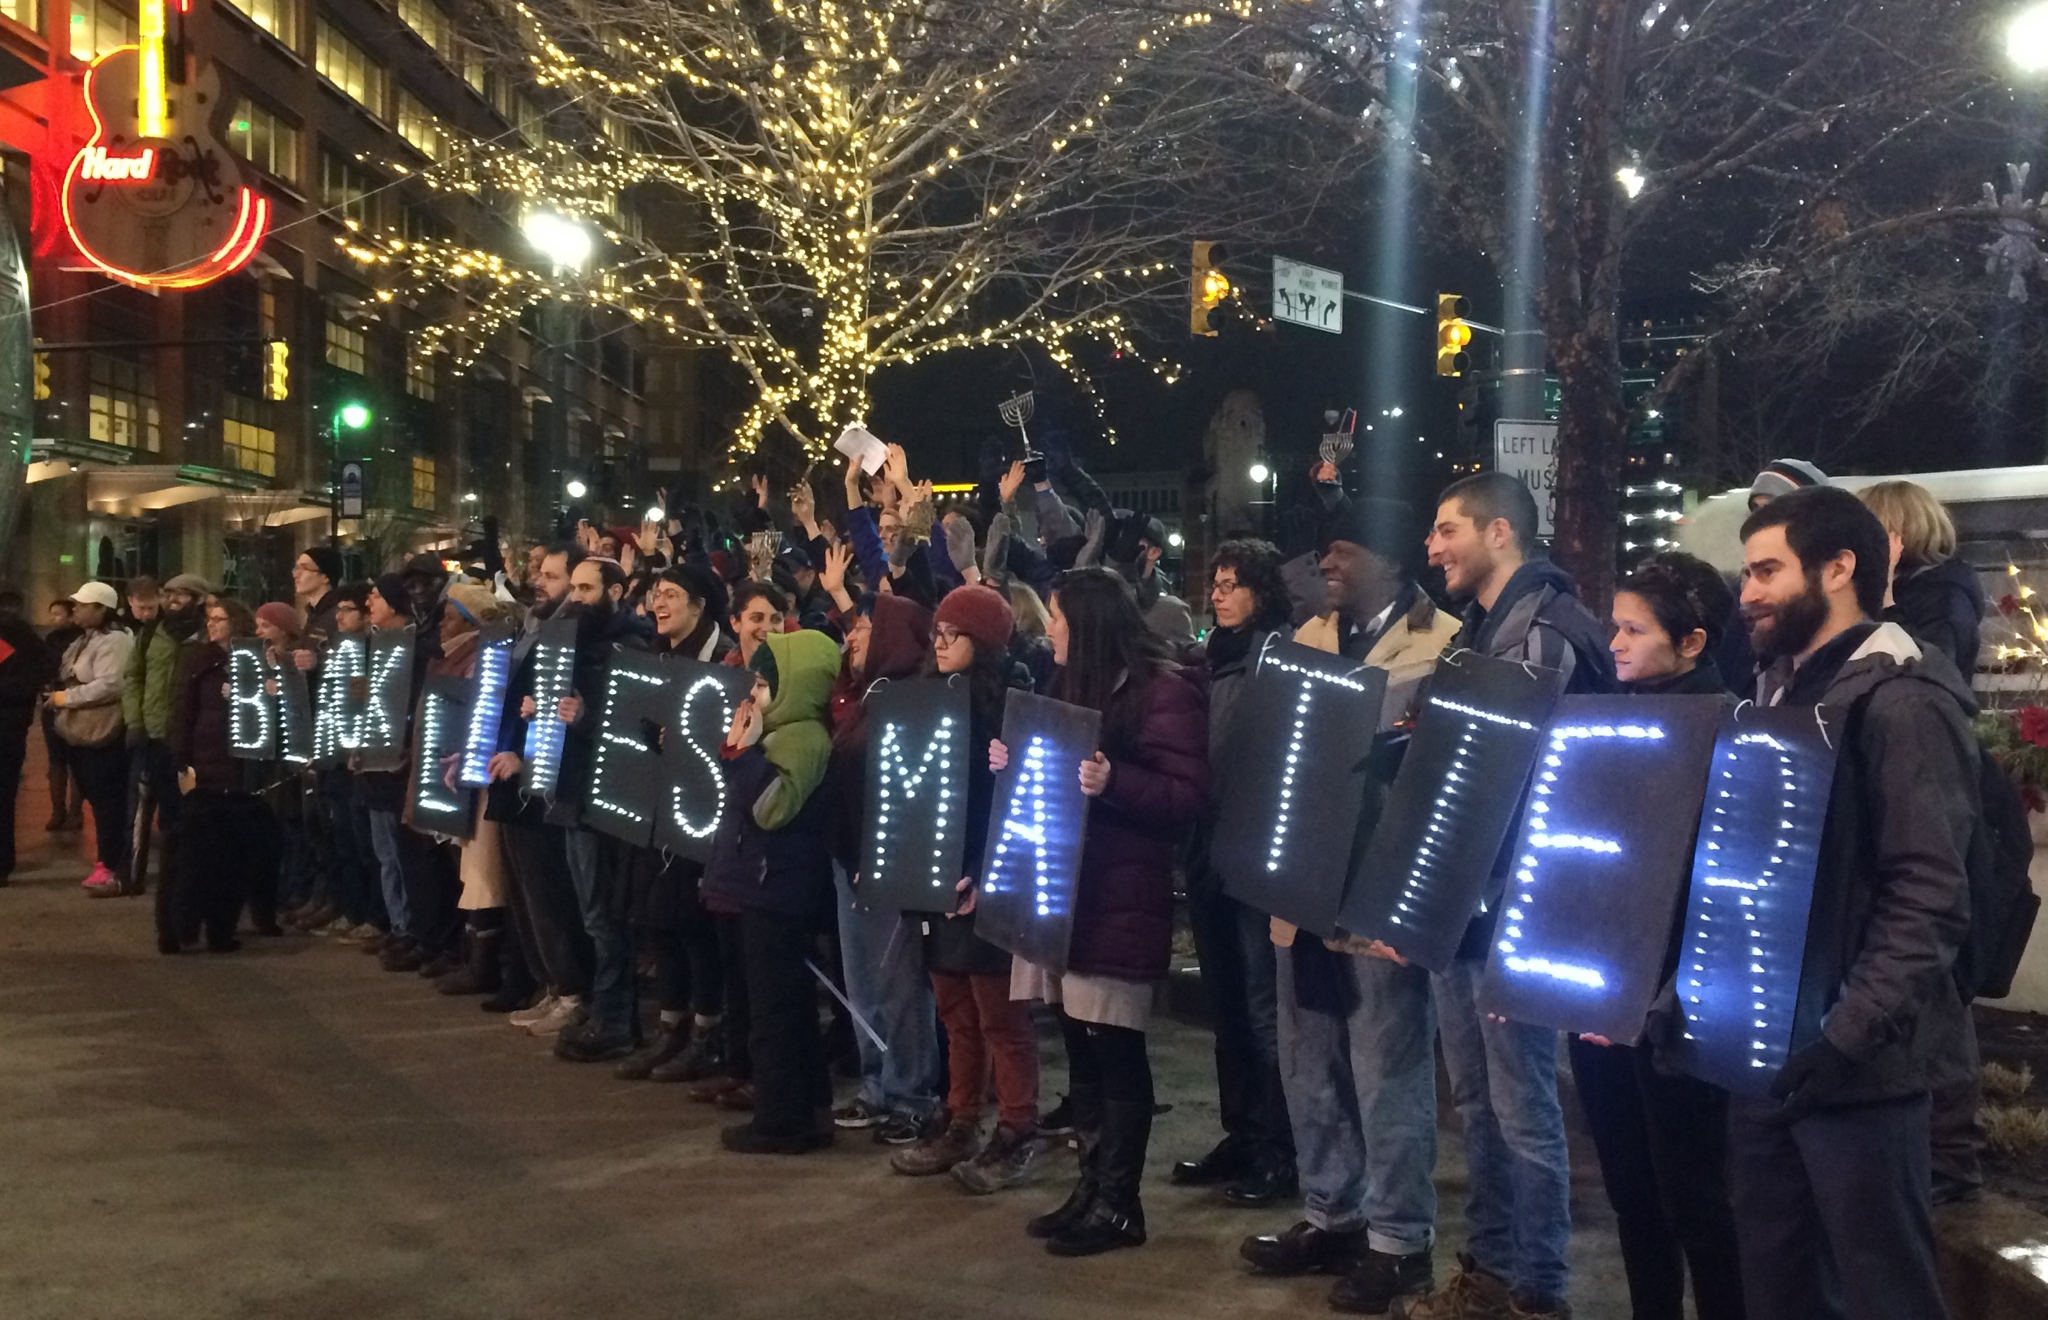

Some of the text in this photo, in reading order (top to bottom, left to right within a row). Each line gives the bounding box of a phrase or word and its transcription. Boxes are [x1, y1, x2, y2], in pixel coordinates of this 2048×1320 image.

[81, 146, 153, 179] Hard
[1503, 437, 1535, 454] LEFT
[1517, 469, 1553, 490] MUS
[230, 639, 1795, 1067] BLACK LIVES MATTER
